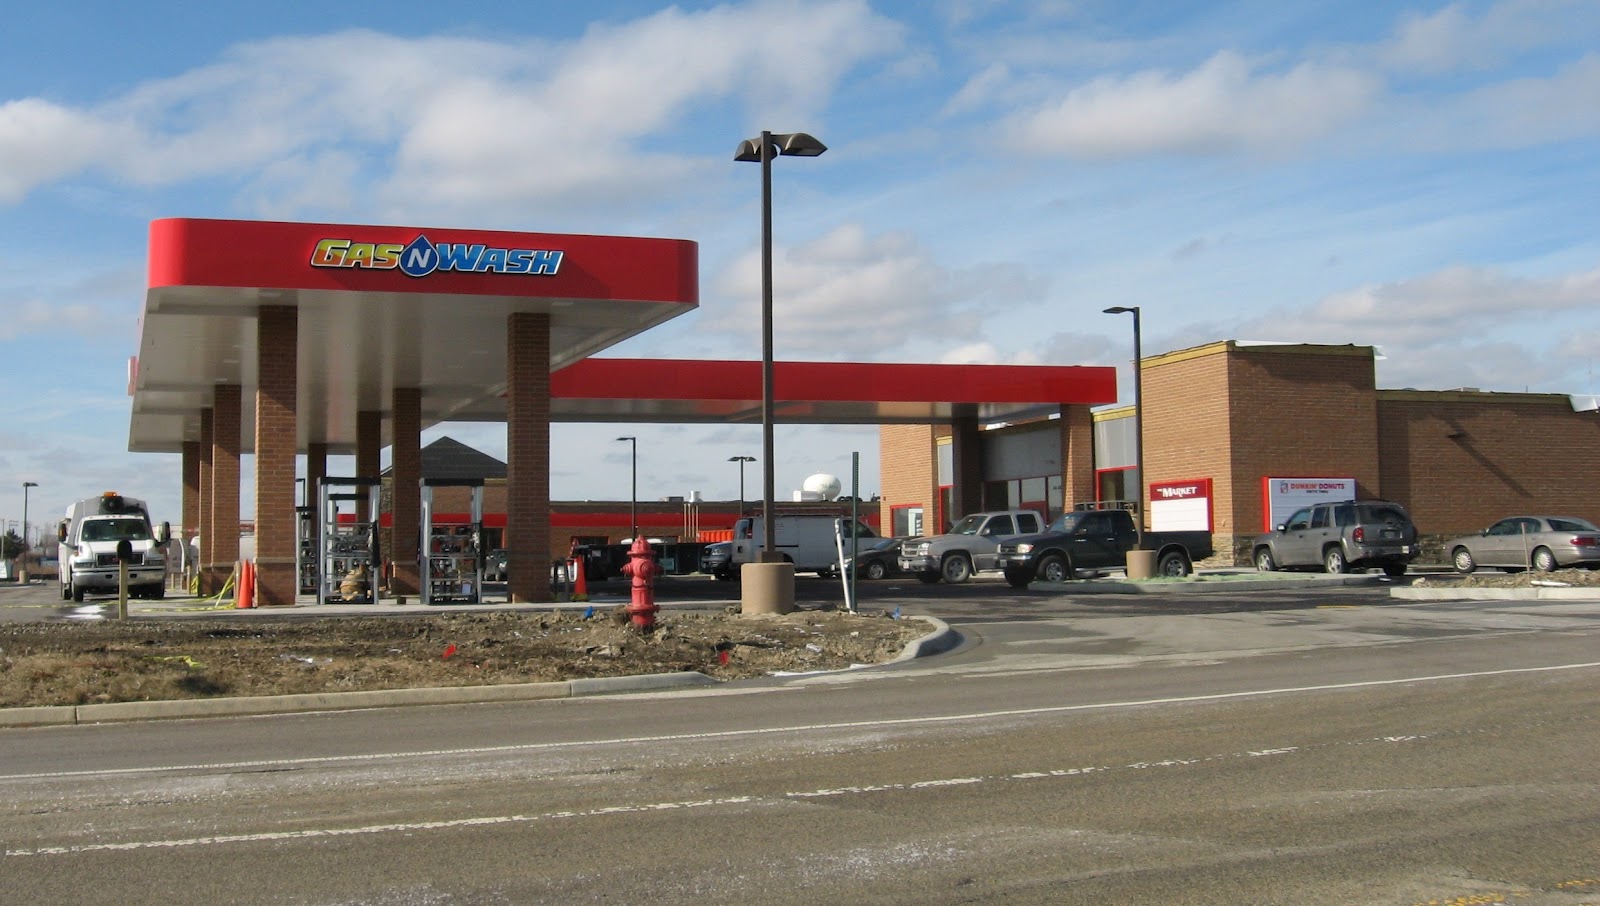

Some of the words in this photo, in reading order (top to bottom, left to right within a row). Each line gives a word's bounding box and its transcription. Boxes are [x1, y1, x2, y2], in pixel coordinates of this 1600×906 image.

[310, 238, 405, 269] GAS
[406, 247, 432, 269] N
[435, 243, 564, 275] WASH
[1162, 486, 1198, 498] MARKET
